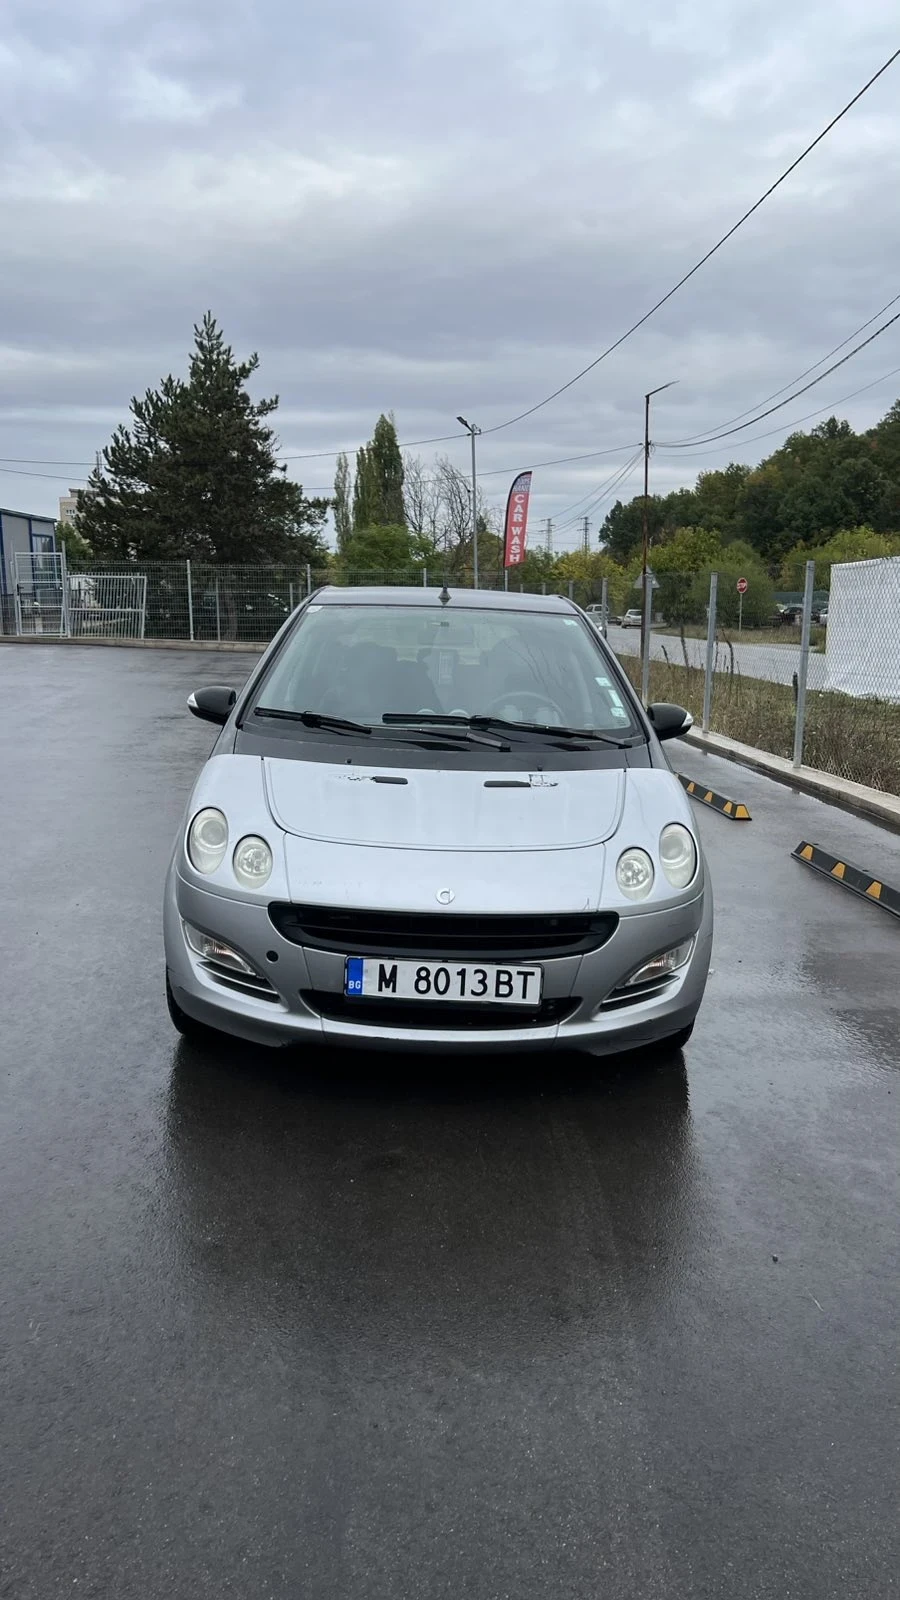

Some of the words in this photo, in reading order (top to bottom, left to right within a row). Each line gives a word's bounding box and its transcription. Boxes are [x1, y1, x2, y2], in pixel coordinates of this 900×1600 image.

[513, 494, 524, 522] CAR
[509, 526, 522, 562] WASH
[348, 980, 361, 989] BG
[378, 963, 398, 993] M
